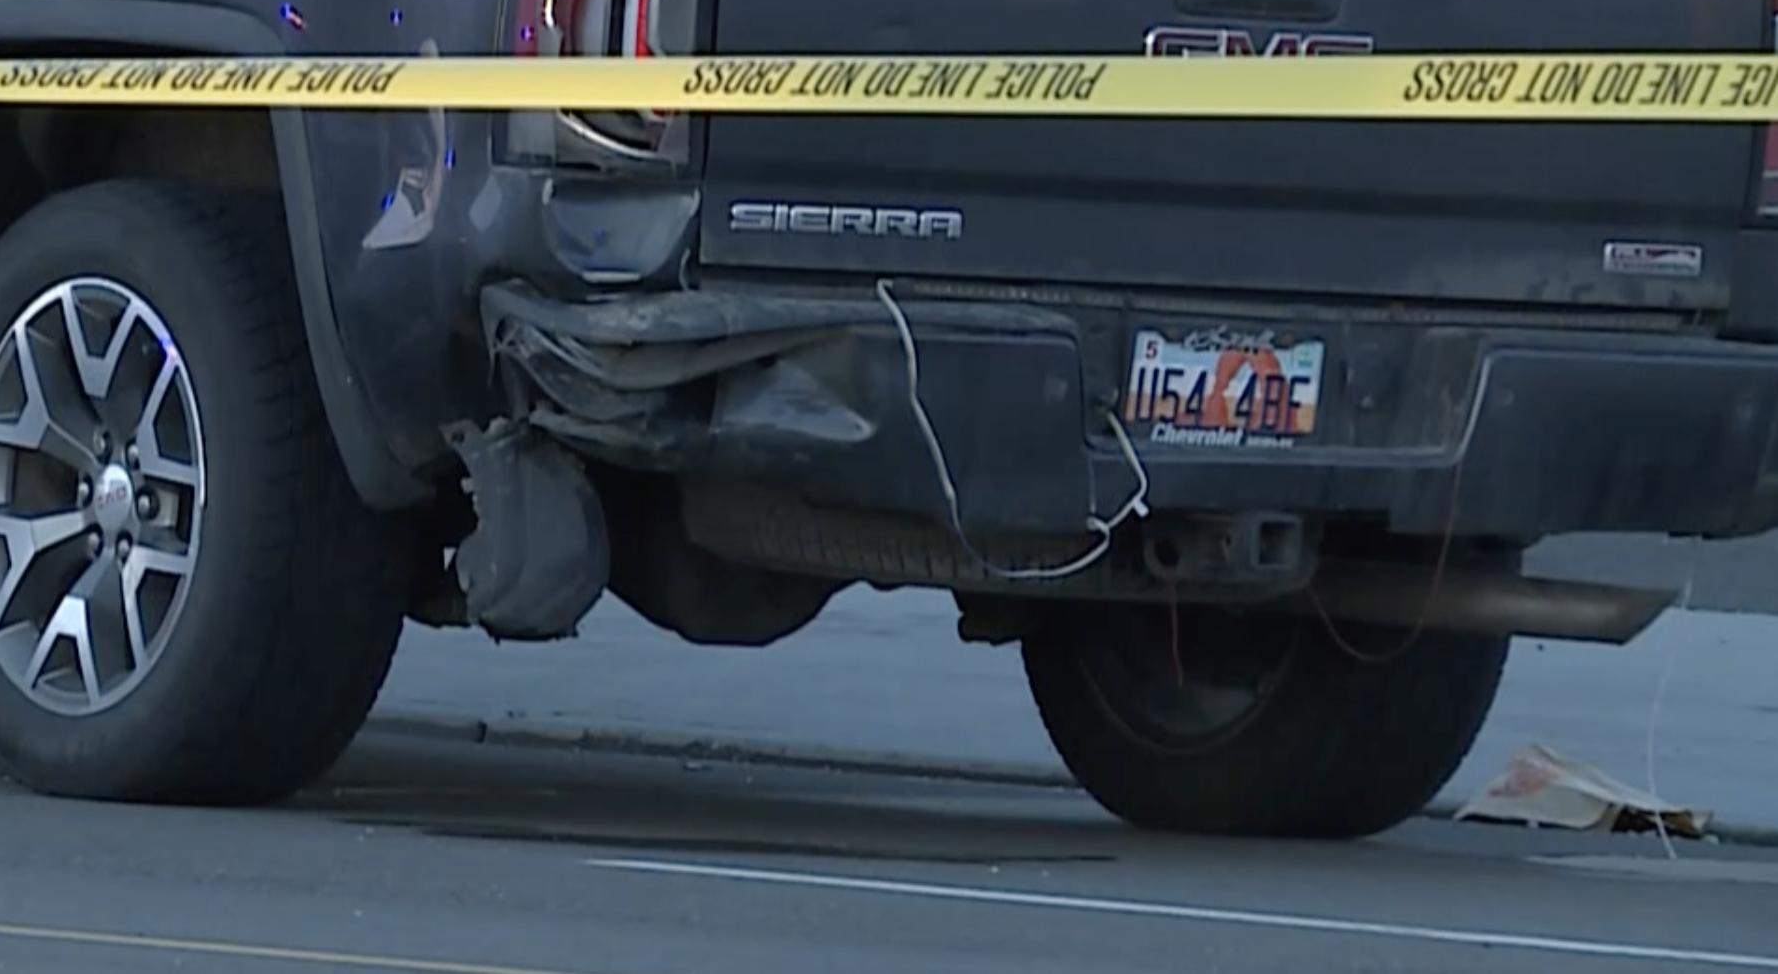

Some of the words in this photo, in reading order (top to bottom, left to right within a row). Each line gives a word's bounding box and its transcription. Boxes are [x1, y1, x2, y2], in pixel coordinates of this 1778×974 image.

[684, 59, 797, 96] CROSS
[790, 60, 867, 97] NOT
[863, 61, 921, 98] DO
[909, 62, 986, 99] LINE
[985, 62, 1108, 100] POLICE
[1403, 59, 1518, 103] CROSS
[1516, 61, 1593, 104] NOT
[1593, 62, 1646, 105] DO
[1640, 63, 1721, 106] LINE
[730, 203, 963, 239] SIERRA
[1136, 366, 1208, 425] U54
